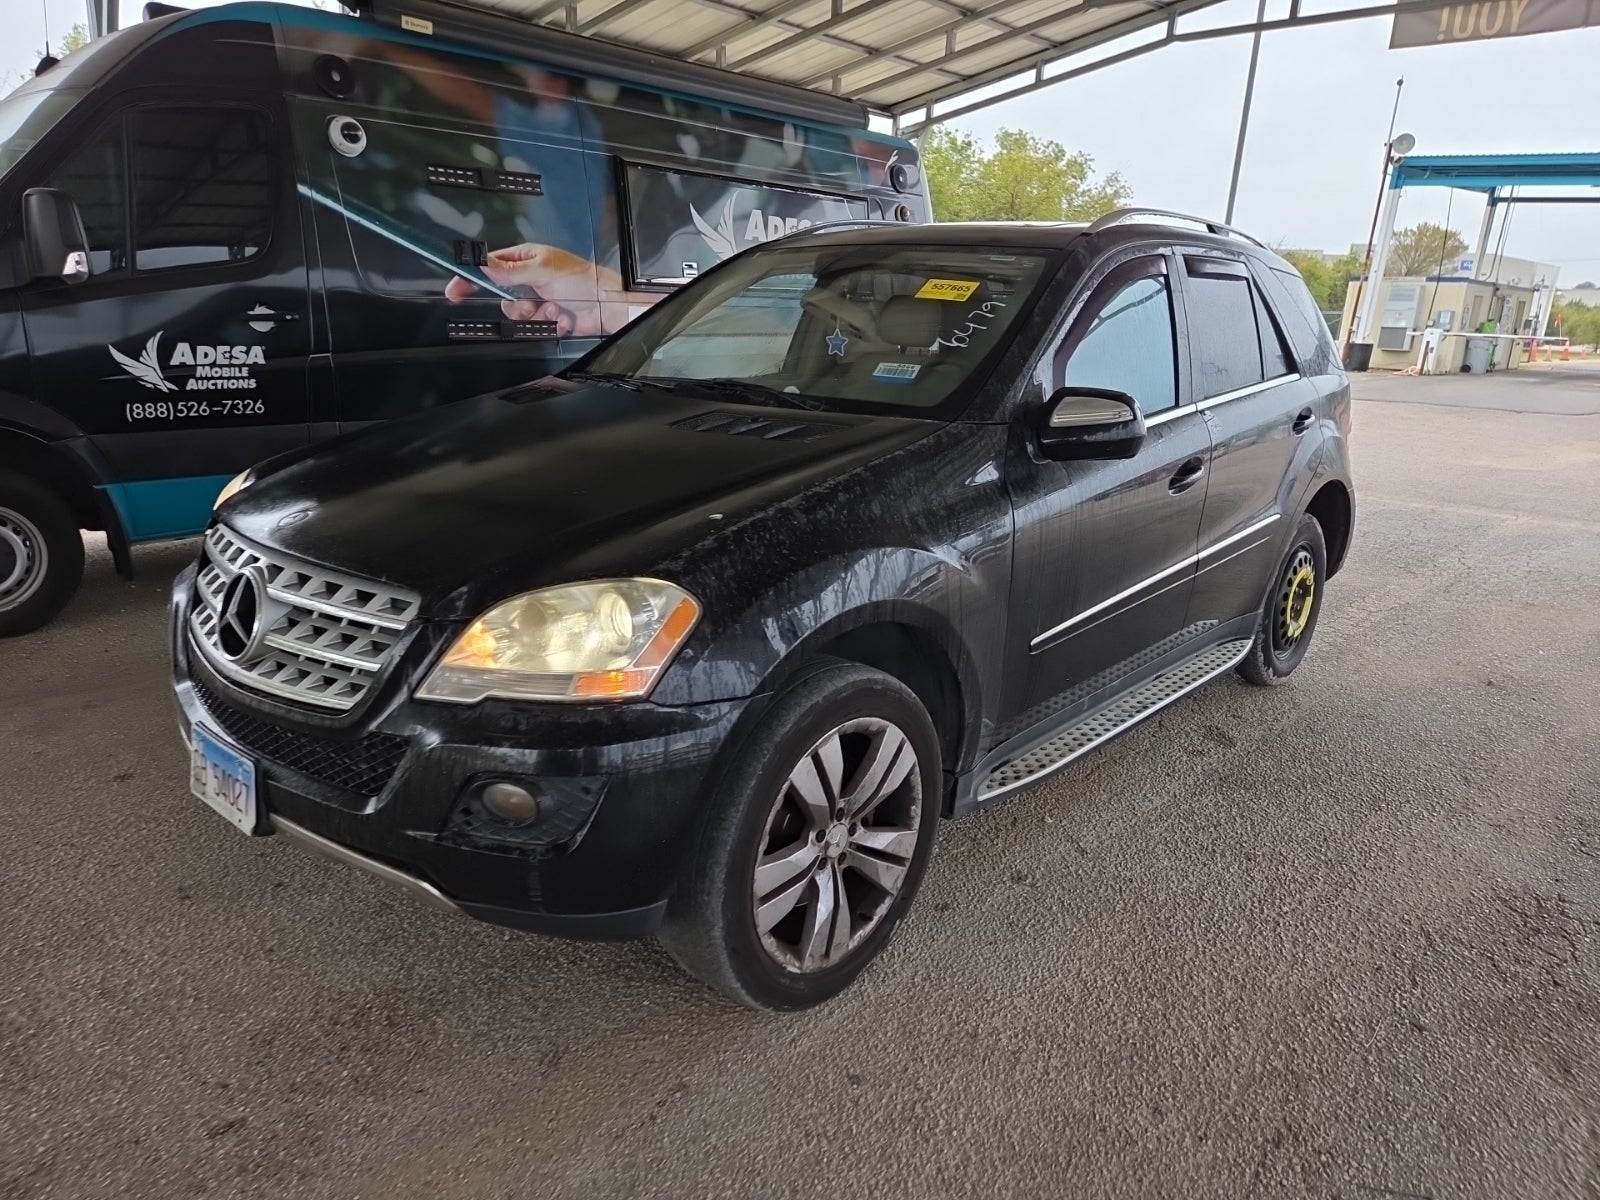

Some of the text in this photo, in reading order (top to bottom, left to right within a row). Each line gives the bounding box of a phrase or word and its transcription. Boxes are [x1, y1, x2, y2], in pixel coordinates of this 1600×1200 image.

[744, 209, 825, 242] ADE
[931, 283, 972, 293] 557665
[169, 342, 266, 365] ADESA
[196, 366, 249, 378] MOBILE
[185, 378, 257, 390] AUCTIONS
